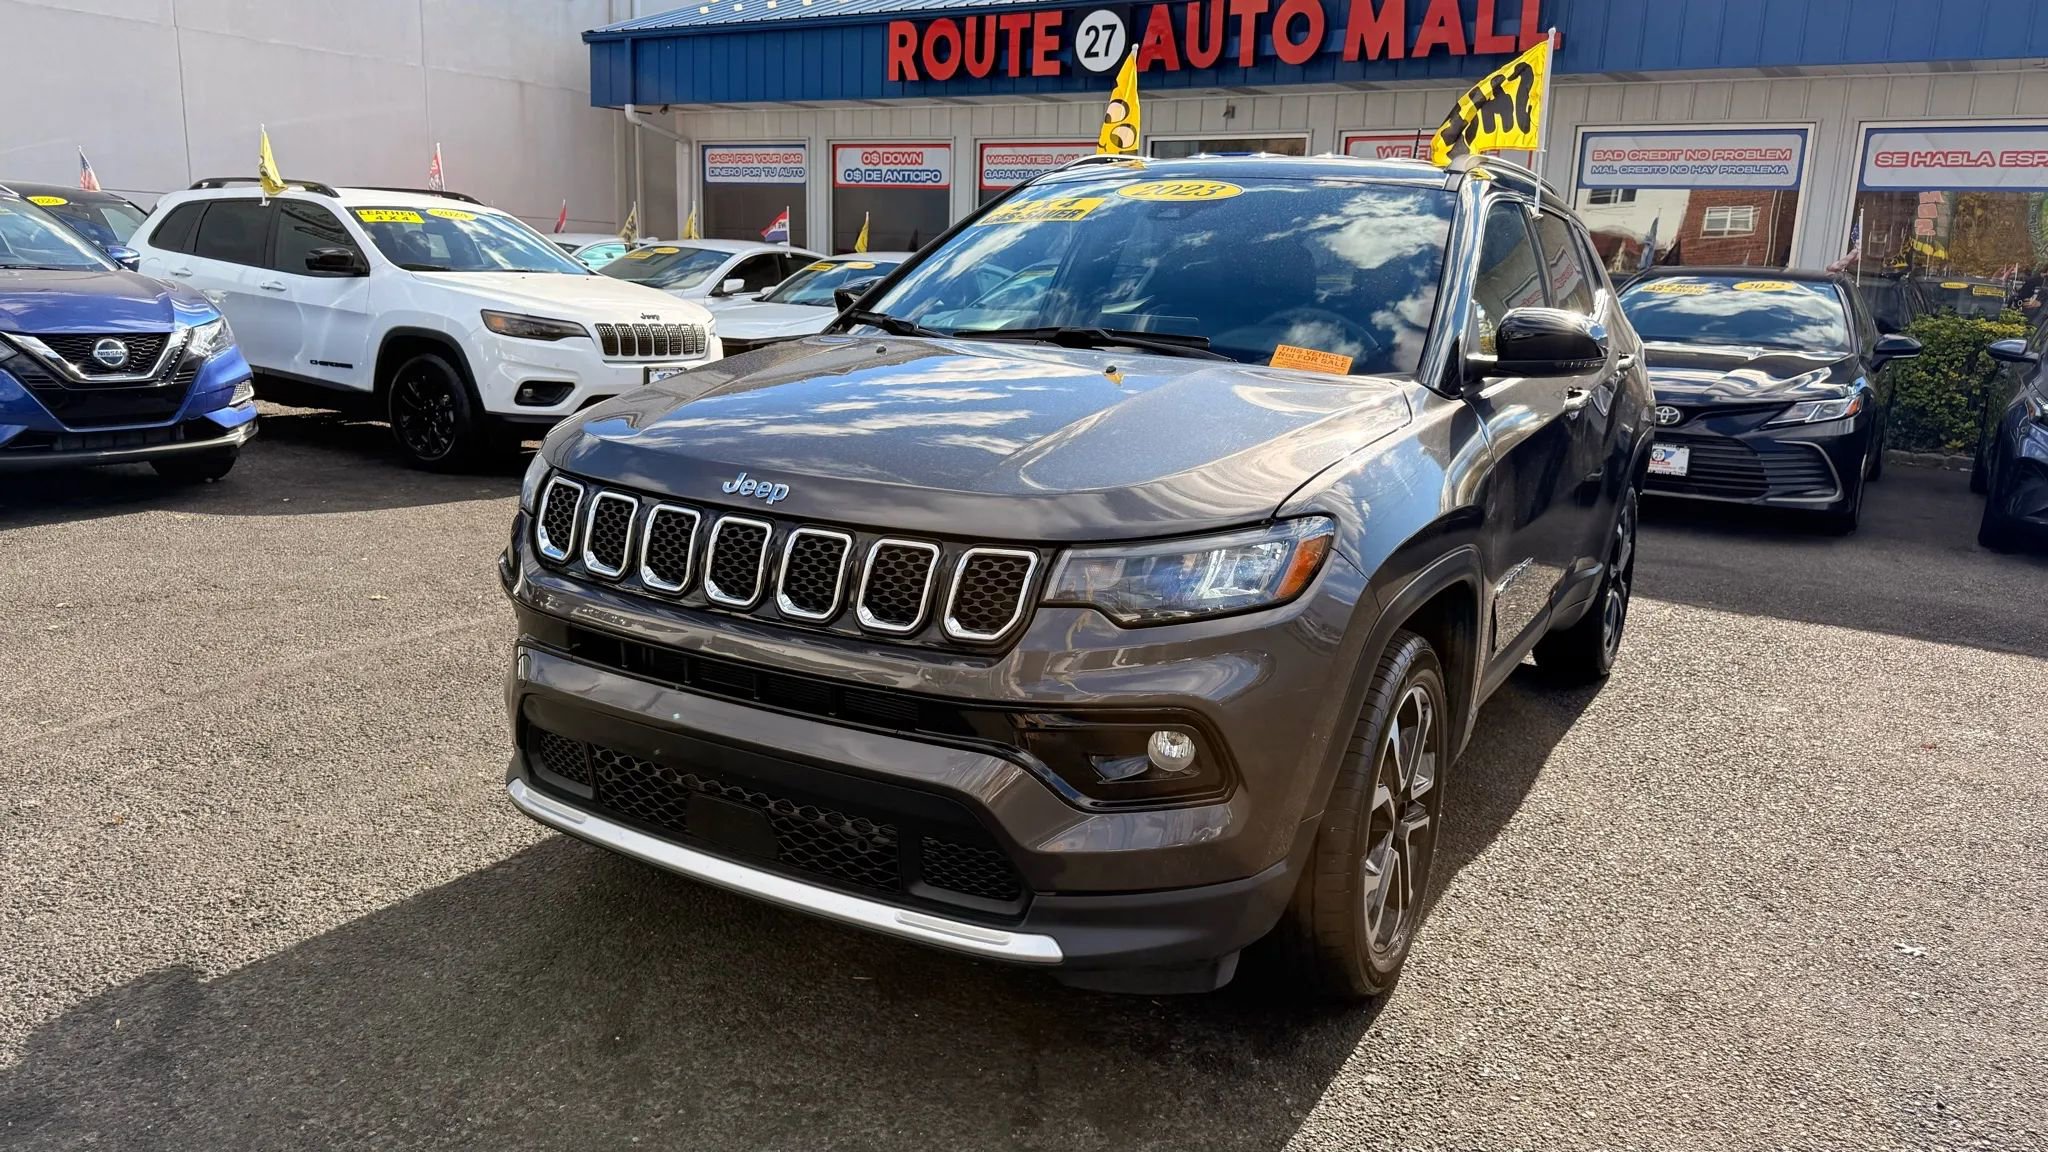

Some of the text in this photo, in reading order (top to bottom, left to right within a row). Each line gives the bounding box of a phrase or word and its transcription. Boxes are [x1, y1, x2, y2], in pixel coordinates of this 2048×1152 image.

[888, 0, 1562, 81] ROUTE 27 AUTO MALL
[709, 153, 803, 163] CASH FOR YOUR CAR
[882, 152, 923, 165] DOWN
[1376, 145, 1412, 159] WE
[1592, 149, 1792, 161] BAD CREDIT NO PROBLEM
[986, 154, 1053, 165] WARRANTIES
[1875, 152, 1909, 167] SE
[1911, 151, 1995, 167] HABLA
[709, 167, 805, 177] DINERO POR TU AUTO
[864, 169, 882, 182] DE
[883, 169, 942, 182] ANTICIPO
[1591, 165, 1788, 174] MAL CREDITO NO HAY PROBLEMA
[1137, 183, 1226, 197] 2023
[722, 472, 789, 505] Jeep
